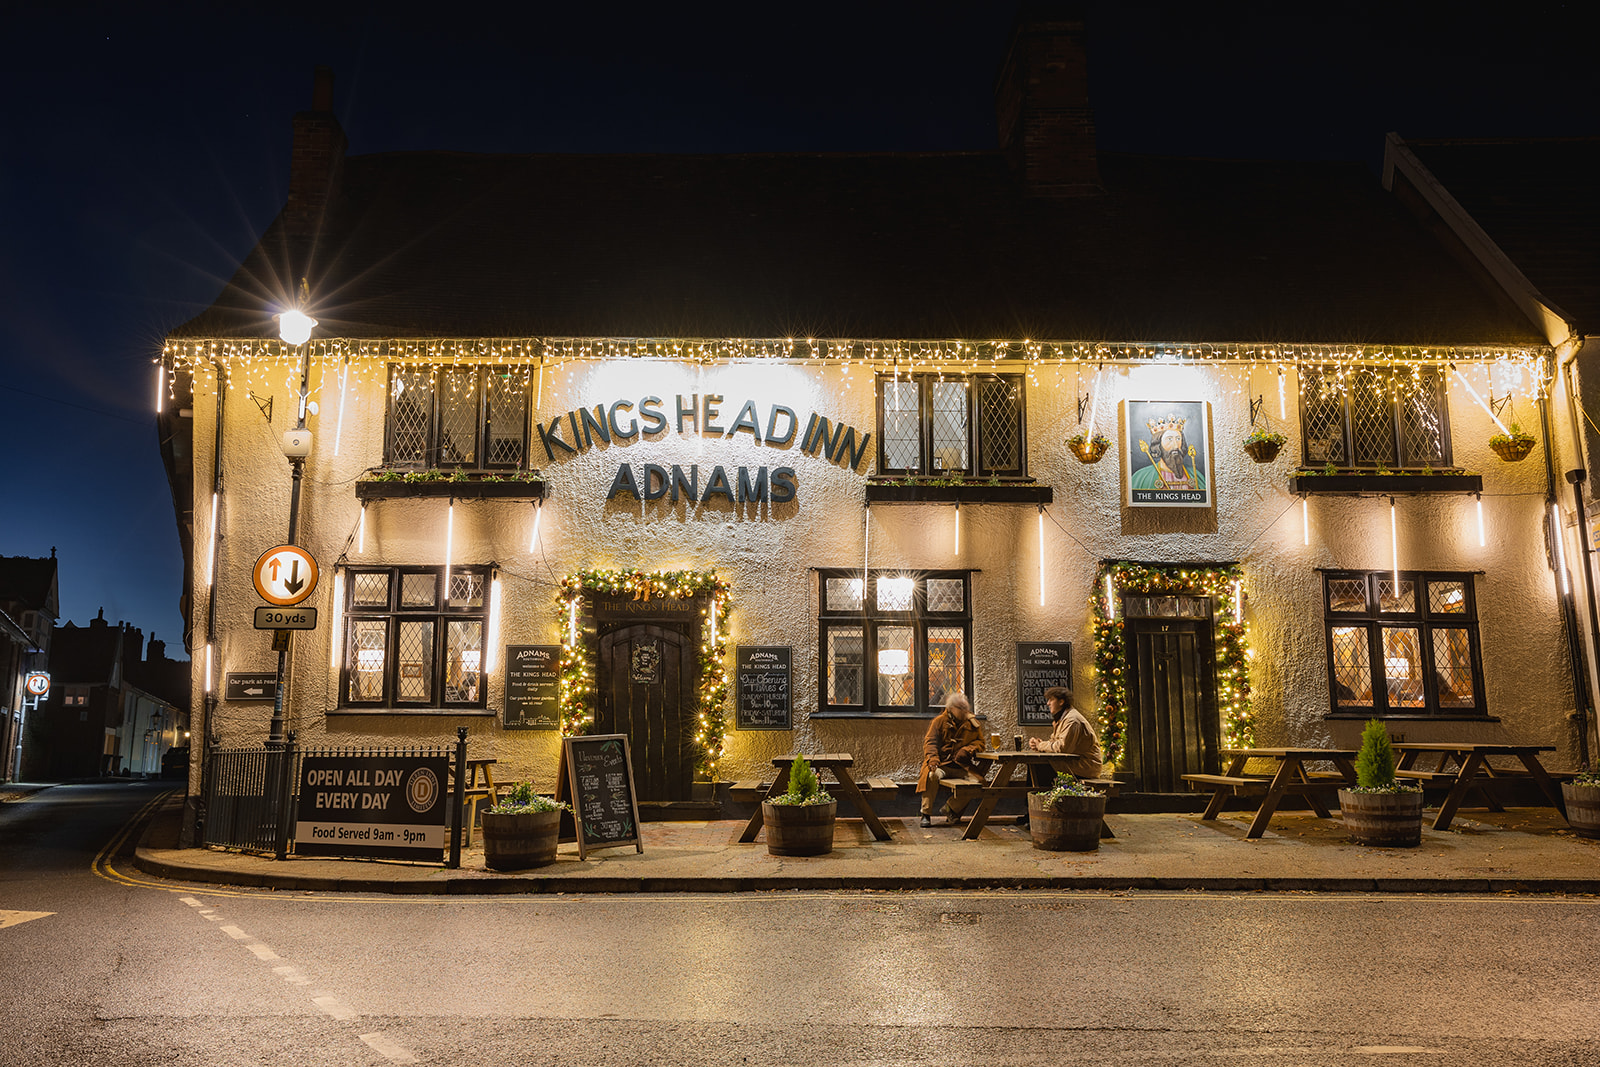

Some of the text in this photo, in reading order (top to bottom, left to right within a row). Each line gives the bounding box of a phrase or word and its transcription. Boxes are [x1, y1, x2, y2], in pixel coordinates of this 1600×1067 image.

[537, 394, 871, 471] KINGS HEAD INN
[606, 462, 797, 504] ADNAMS
[1137, 492, 1202, 501] THE KINGS HEAD
[601, 601, 621, 612] THE
[661, 601, 691, 612] HEAD
[265, 613, 306, 625] 30 yds
[515, 650, 551, 660] ADNAMS
[749, 652, 779, 661] ADNAMS
[1029, 647, 1059, 657] ADNAMS
[1023, 669, 1067, 679] ADDITIONAL
[241, 678, 256, 686] park
[1023, 678, 1067, 687] SEATING IN
[1024, 687, 1043, 696] OUR
[1024, 704, 1037, 712] WE
[307, 769, 404, 787] OPEN ALL DAY
[315, 792, 391, 810] EVERY DAY
[312, 826, 336, 838] Food
[338, 827, 371, 840] Served
[373, 828, 395, 841] 9am
[403, 829, 426, 844] 9pm
